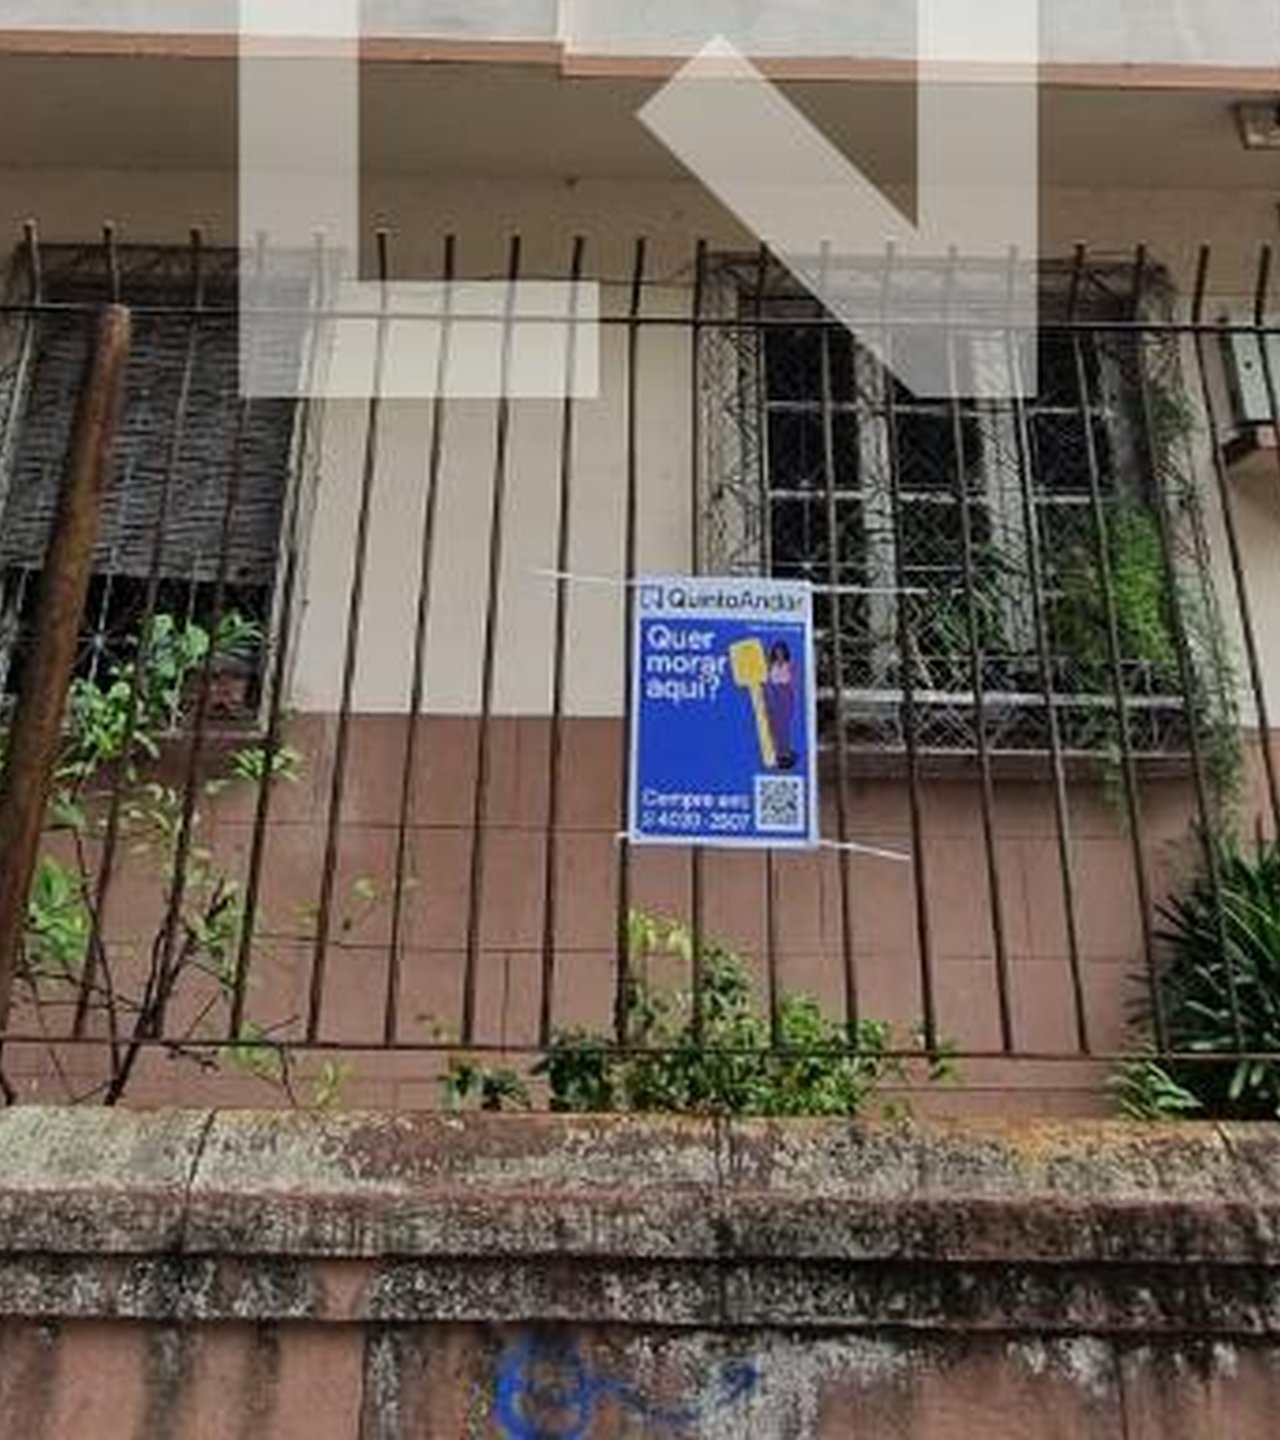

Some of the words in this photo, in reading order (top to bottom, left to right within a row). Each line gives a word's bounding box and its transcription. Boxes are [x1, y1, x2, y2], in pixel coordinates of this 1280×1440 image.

[668, 586, 806, 611] QuintoAndar
[646, 623, 717, 650] Quer
[646, 655, 728, 675] morar
[646, 675, 721, 702] aqui?
